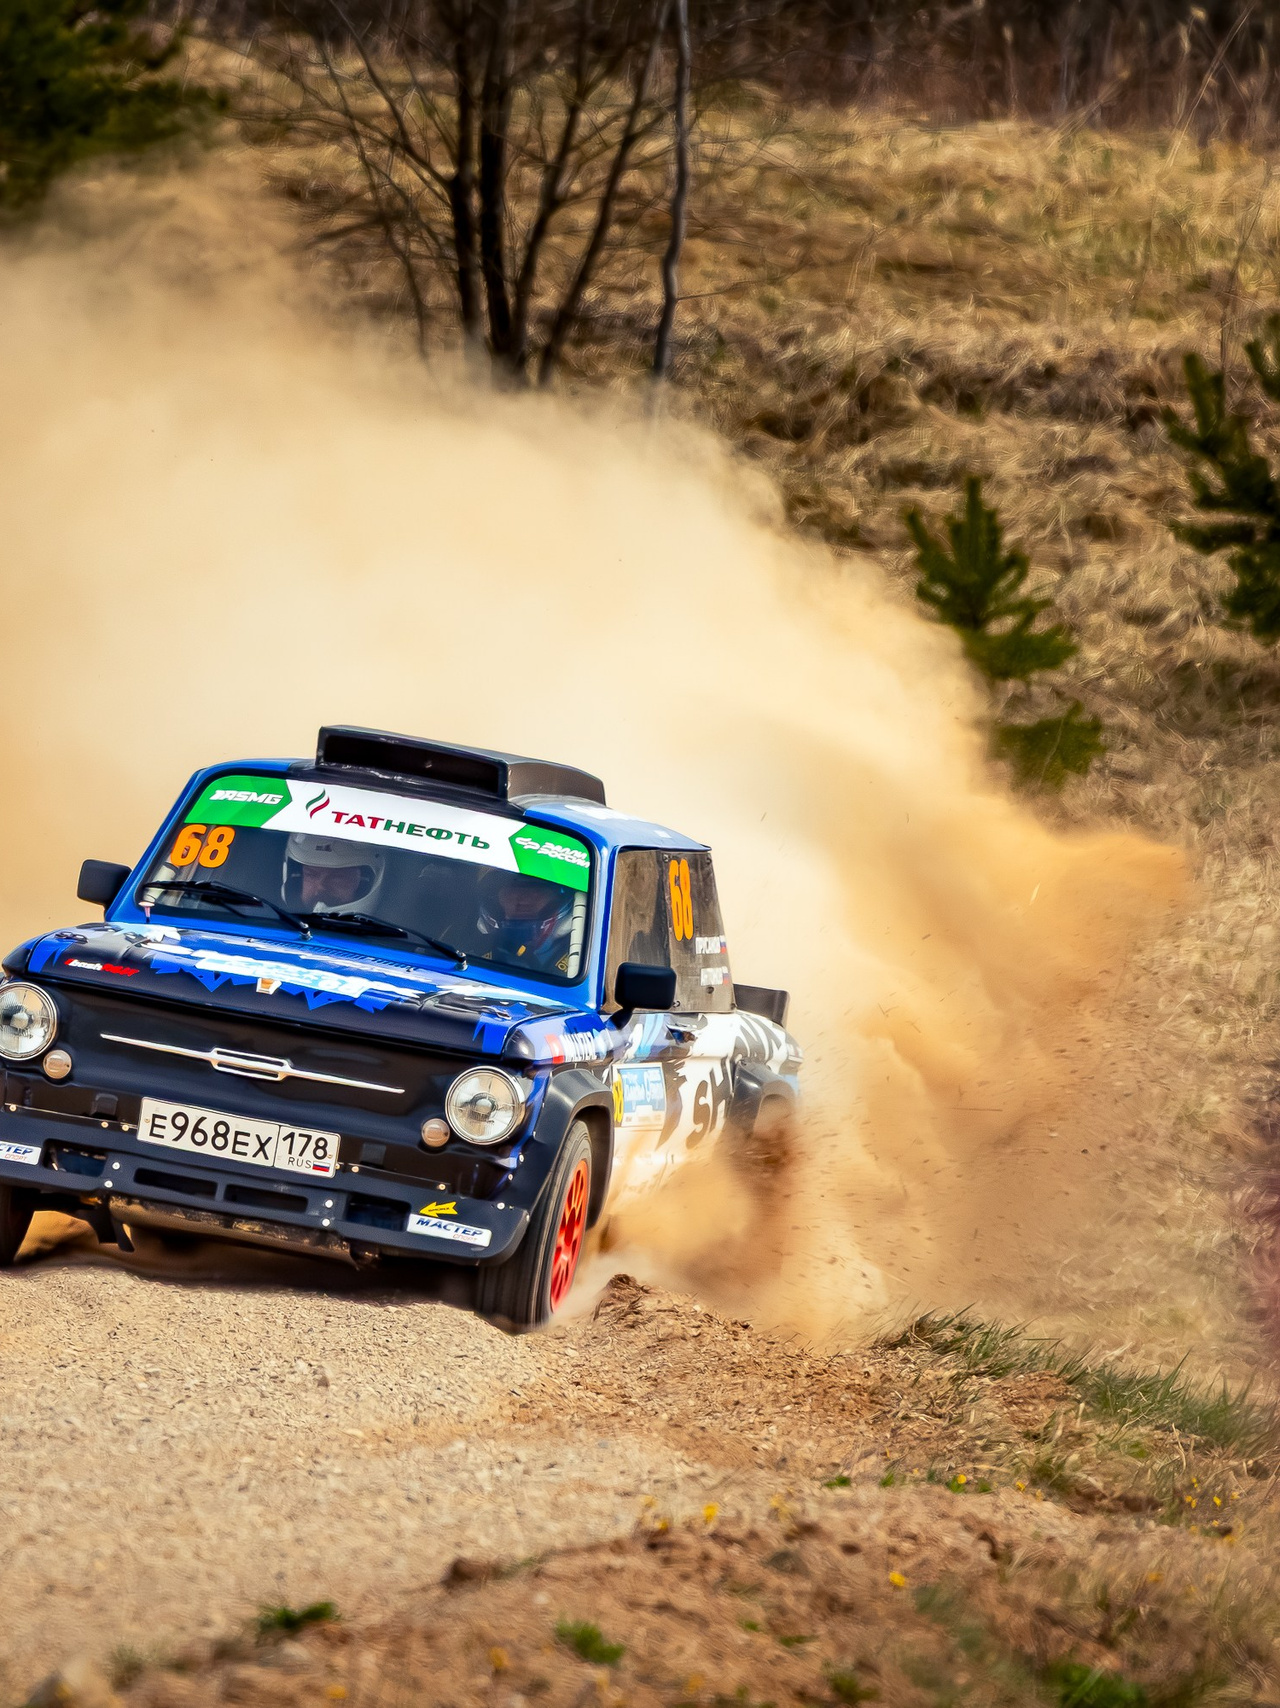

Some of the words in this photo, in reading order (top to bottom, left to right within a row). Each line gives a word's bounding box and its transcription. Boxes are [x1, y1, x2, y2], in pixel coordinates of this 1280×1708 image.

[170, 824, 236, 868] 68
[331, 811, 490, 850] ТАТНЕФТЬ
[669, 859, 694, 942] 68
[282, 1131, 329, 1160] 178
[287, 1156, 312, 1169] RUS
[416, 1217, 483, 1236] МАСТЕР
